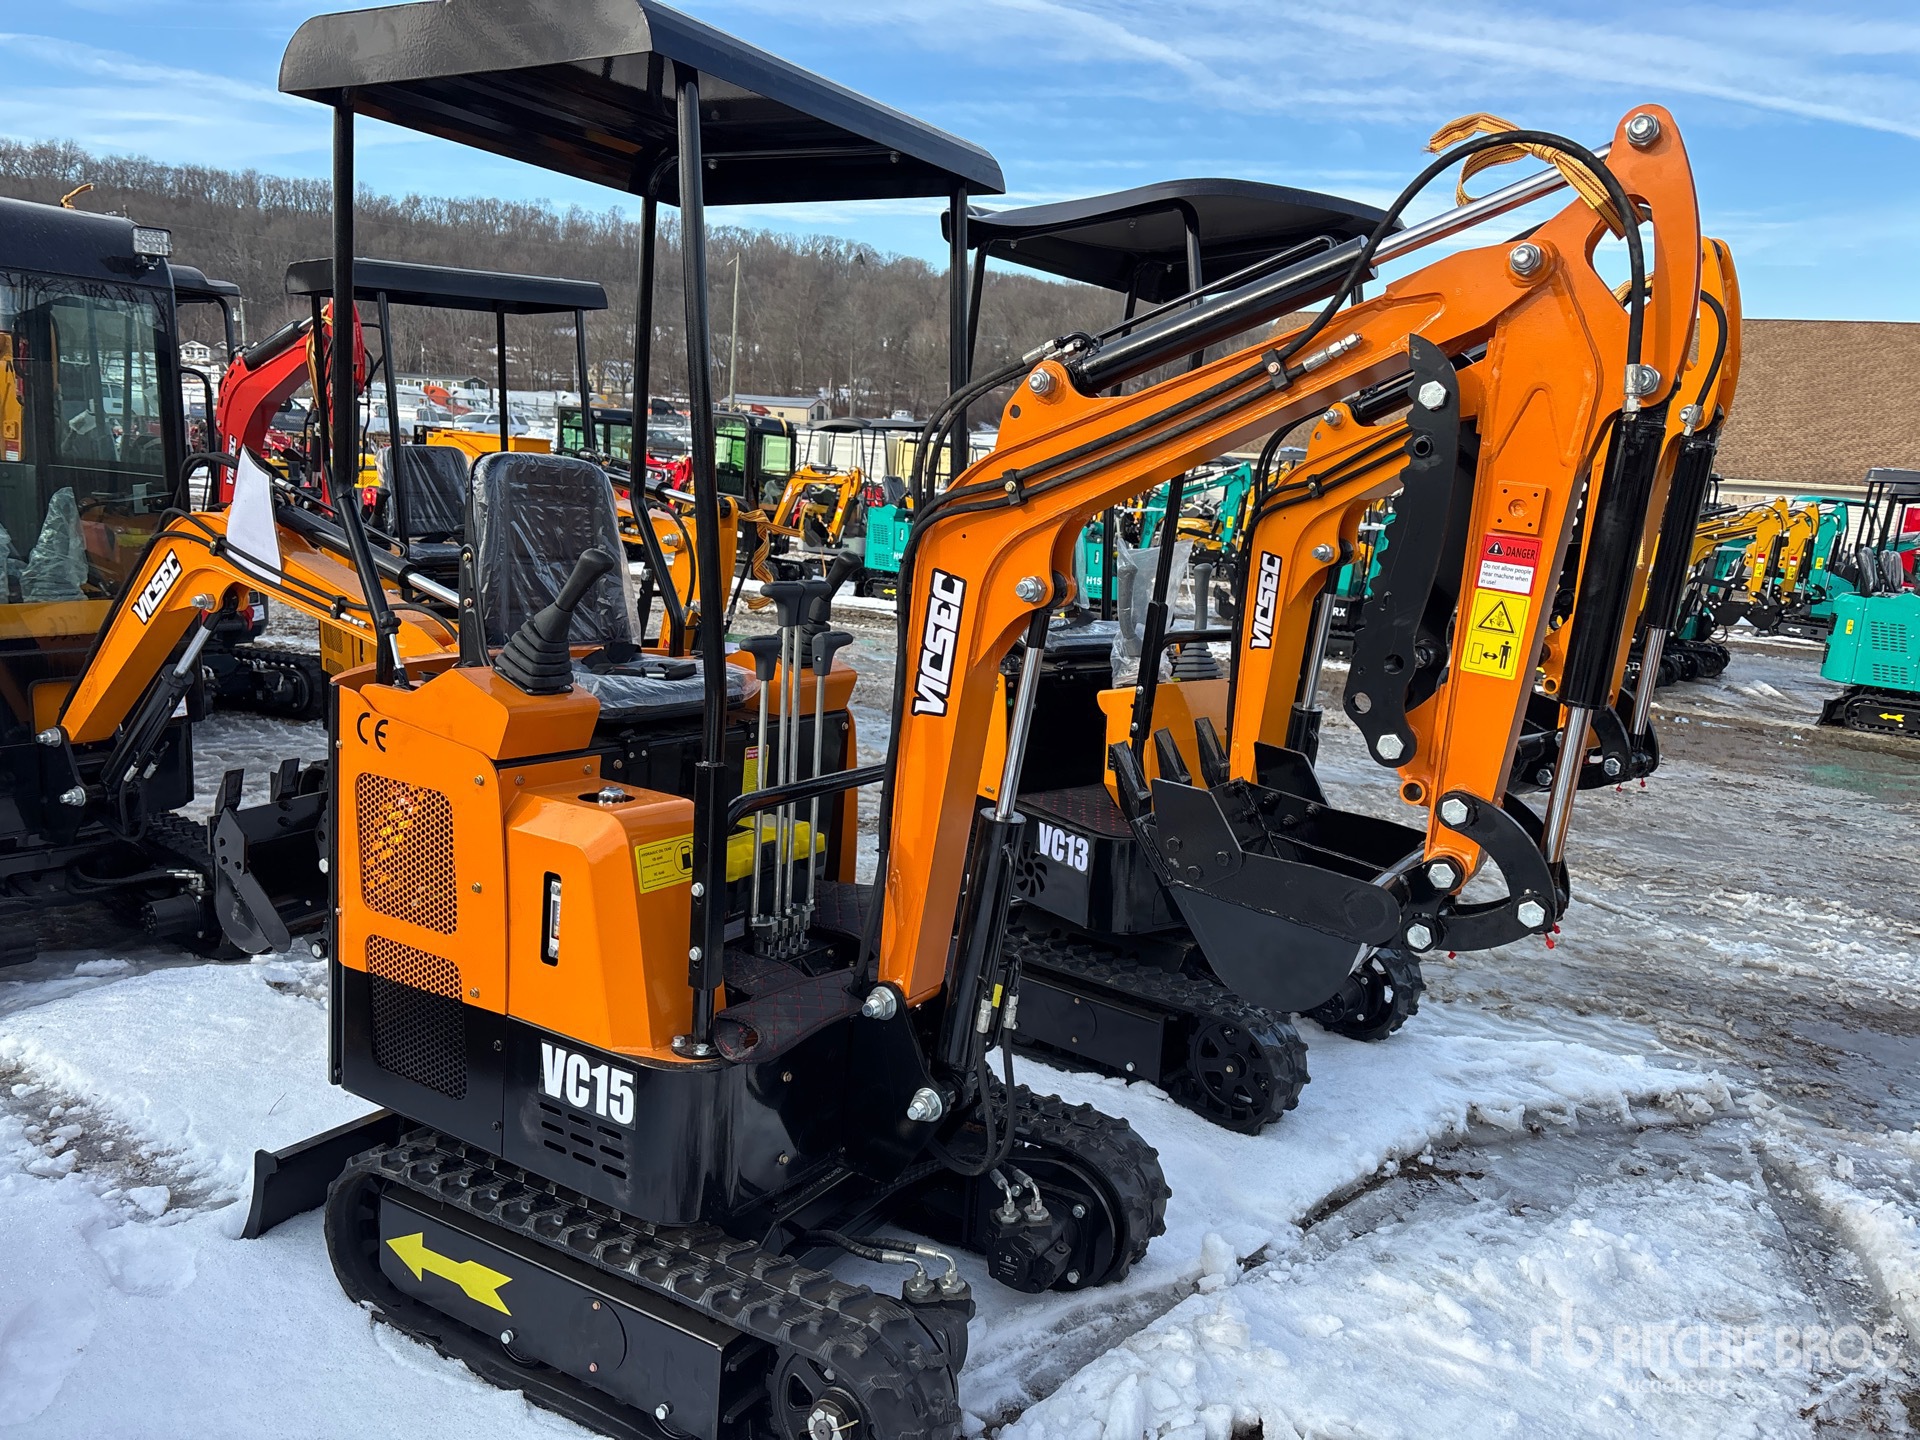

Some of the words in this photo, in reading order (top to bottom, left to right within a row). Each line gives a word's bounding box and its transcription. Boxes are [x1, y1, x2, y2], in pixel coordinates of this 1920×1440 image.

[226, 434, 237, 485] VIEC
[1491, 563, 1501, 571] not
[1514, 567, 1532, 576] people
[1493, 571, 1515, 581] machine
[1514, 574, 1529, 582] when
[1505, 546, 1536, 560] DANGER
[132, 550, 182, 624] VICSEC
[1251, 552, 1281, 648] VICSEC
[913, 570, 965, 715] VICSEC
[356, 711, 389, 753] CE
[1038, 821, 1089, 872] VC13
[541, 1042, 634, 1125] VC15
